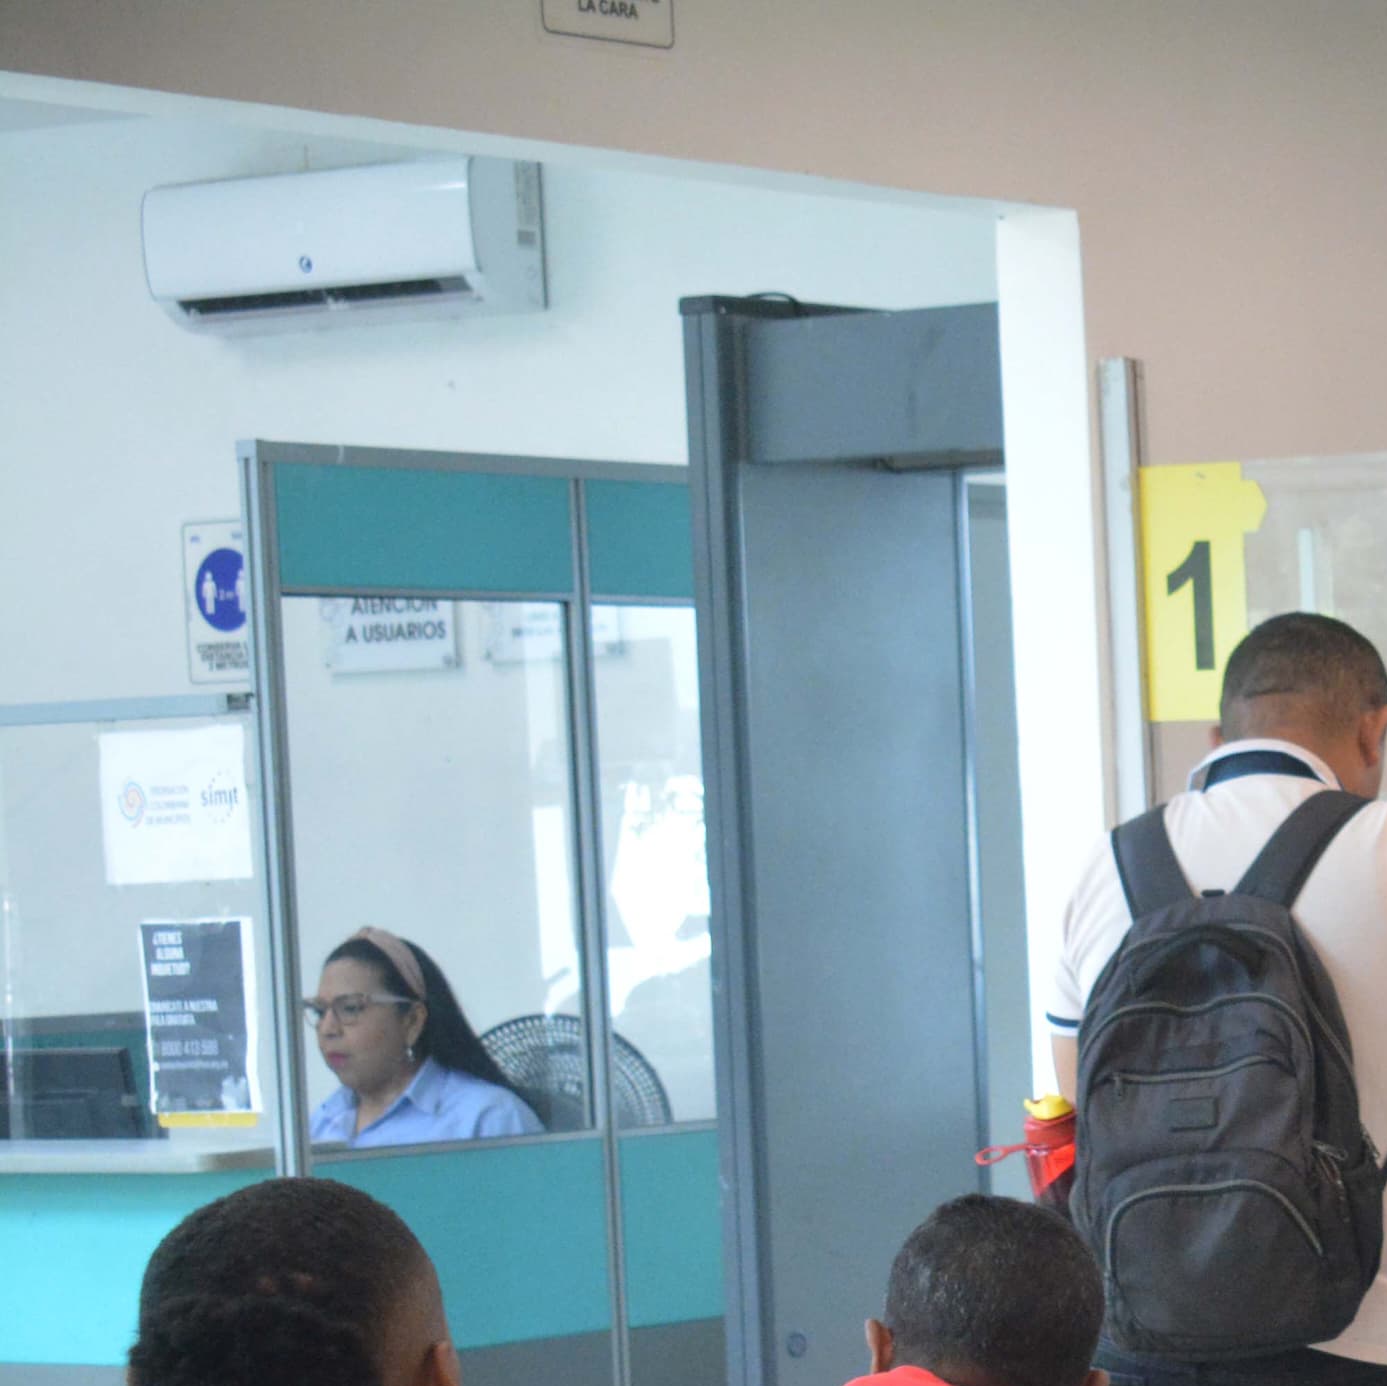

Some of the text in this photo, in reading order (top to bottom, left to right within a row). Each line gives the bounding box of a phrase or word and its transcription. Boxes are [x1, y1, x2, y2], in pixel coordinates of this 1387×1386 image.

[600, 0, 638, 19] CARA
[1166, 540, 1216, 671] 1
[345, 620, 446, 643] A USUARIOS
